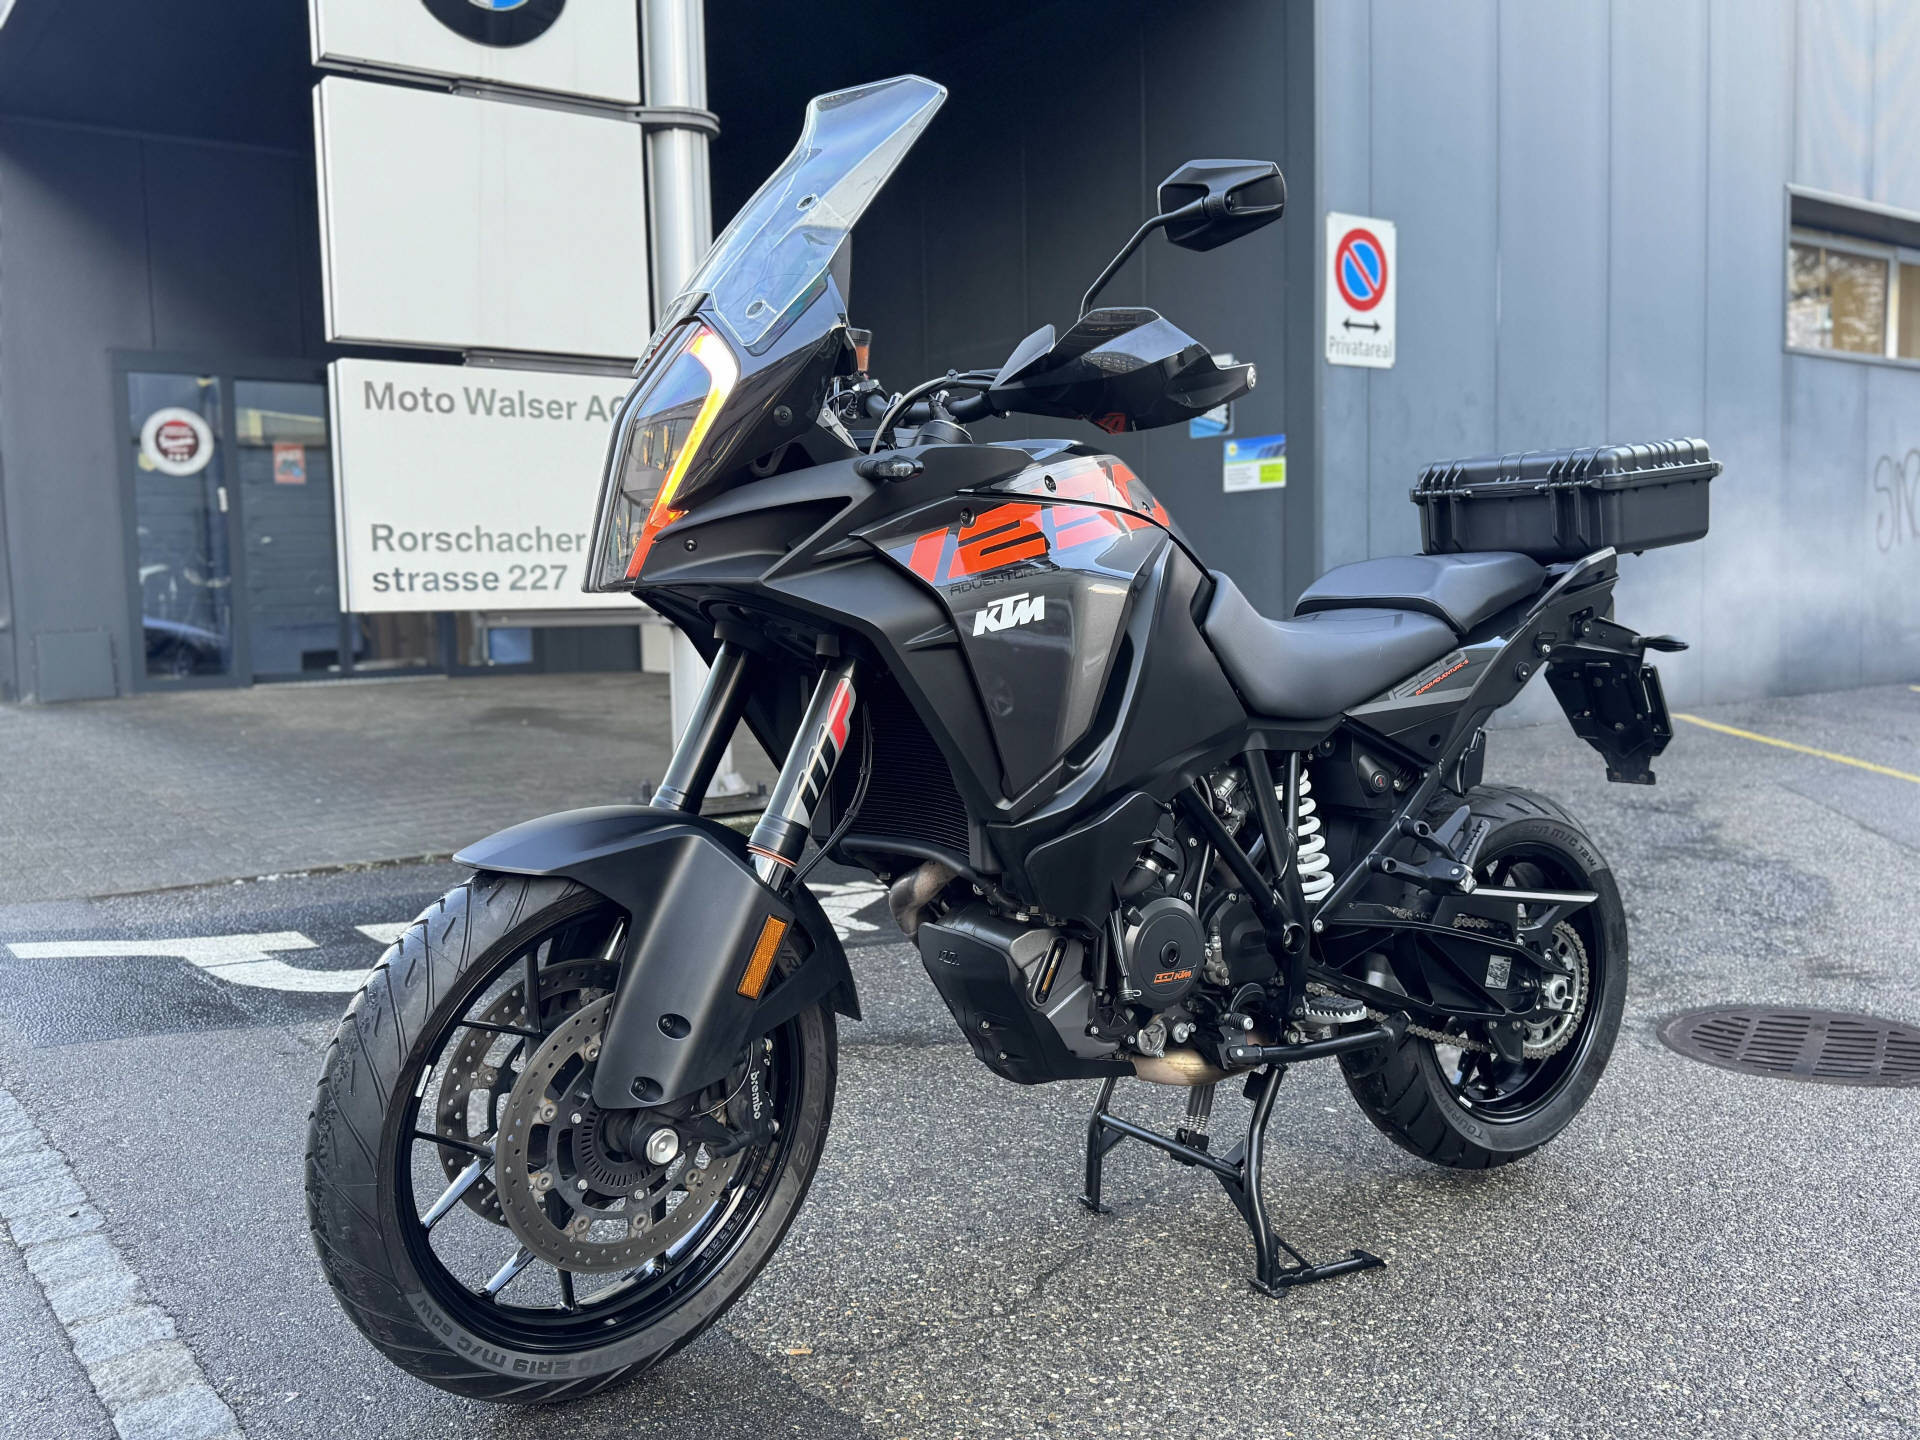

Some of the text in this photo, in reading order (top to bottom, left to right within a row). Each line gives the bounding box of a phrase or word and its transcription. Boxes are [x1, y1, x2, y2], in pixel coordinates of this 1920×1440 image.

[1329, 335, 1393, 359] Privatareal
[363, 381, 456, 414] Moto
[463, 386, 578, 421] Walser
[370, 523, 587, 553] Rorschacher
[372, 564, 568, 593] strasse 227
[973, 592, 1045, 637] KTM
[749, 1070, 763, 1120] brembo
[417, 1299, 454, 1338] 60W
